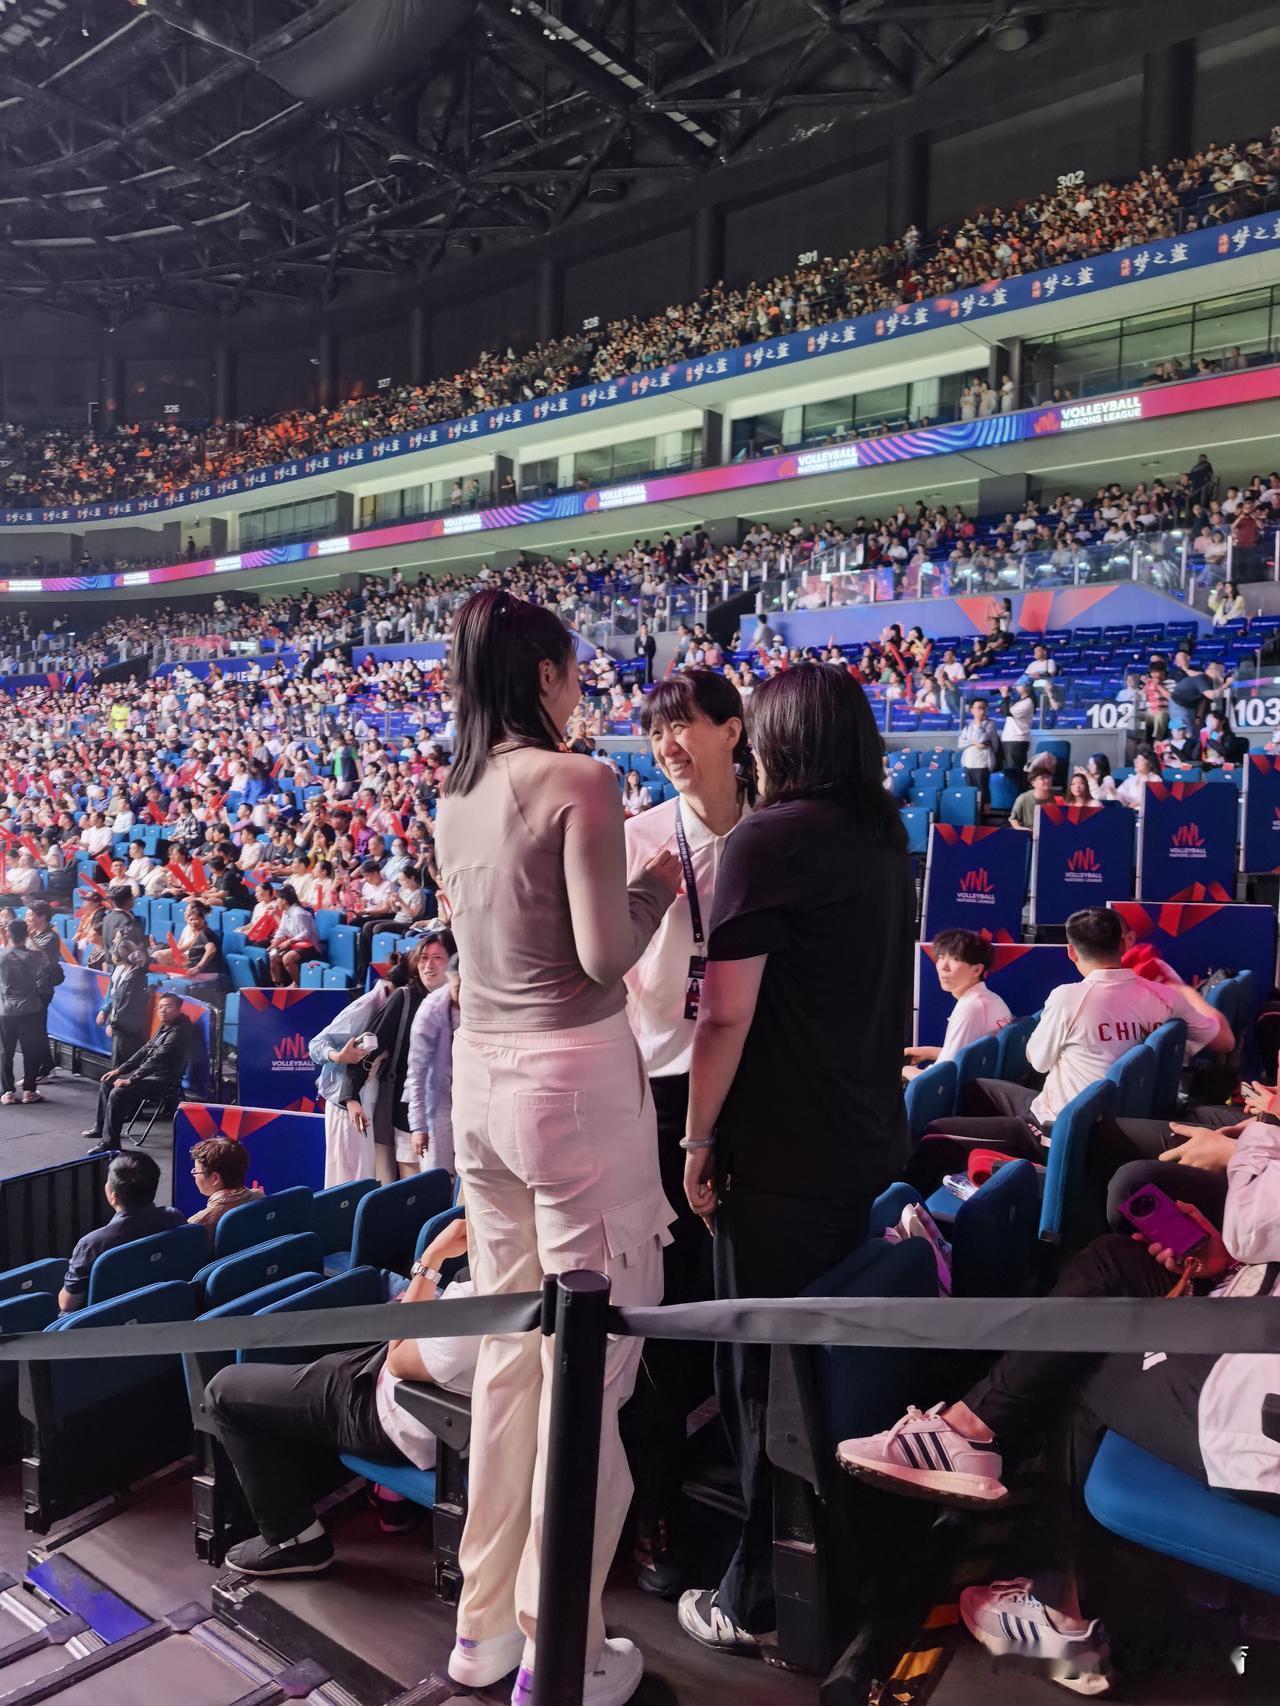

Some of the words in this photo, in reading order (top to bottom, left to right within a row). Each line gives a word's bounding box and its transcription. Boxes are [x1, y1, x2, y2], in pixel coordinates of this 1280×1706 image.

[1057, 170, 1085, 188] 302
[797, 250, 818, 266] 301
[1061, 397, 1141, 419] VOLLEYBALL
[1061, 415, 1103, 428] NATIONS
[1104, 408, 1141, 421] LEAGUE
[797, 446, 858, 465] VOLLEYBALL
[1087, 703, 1134, 729] 102
[1234, 698, 1280, 727] 103
[957, 892, 995, 900] VOLLEYBALL
